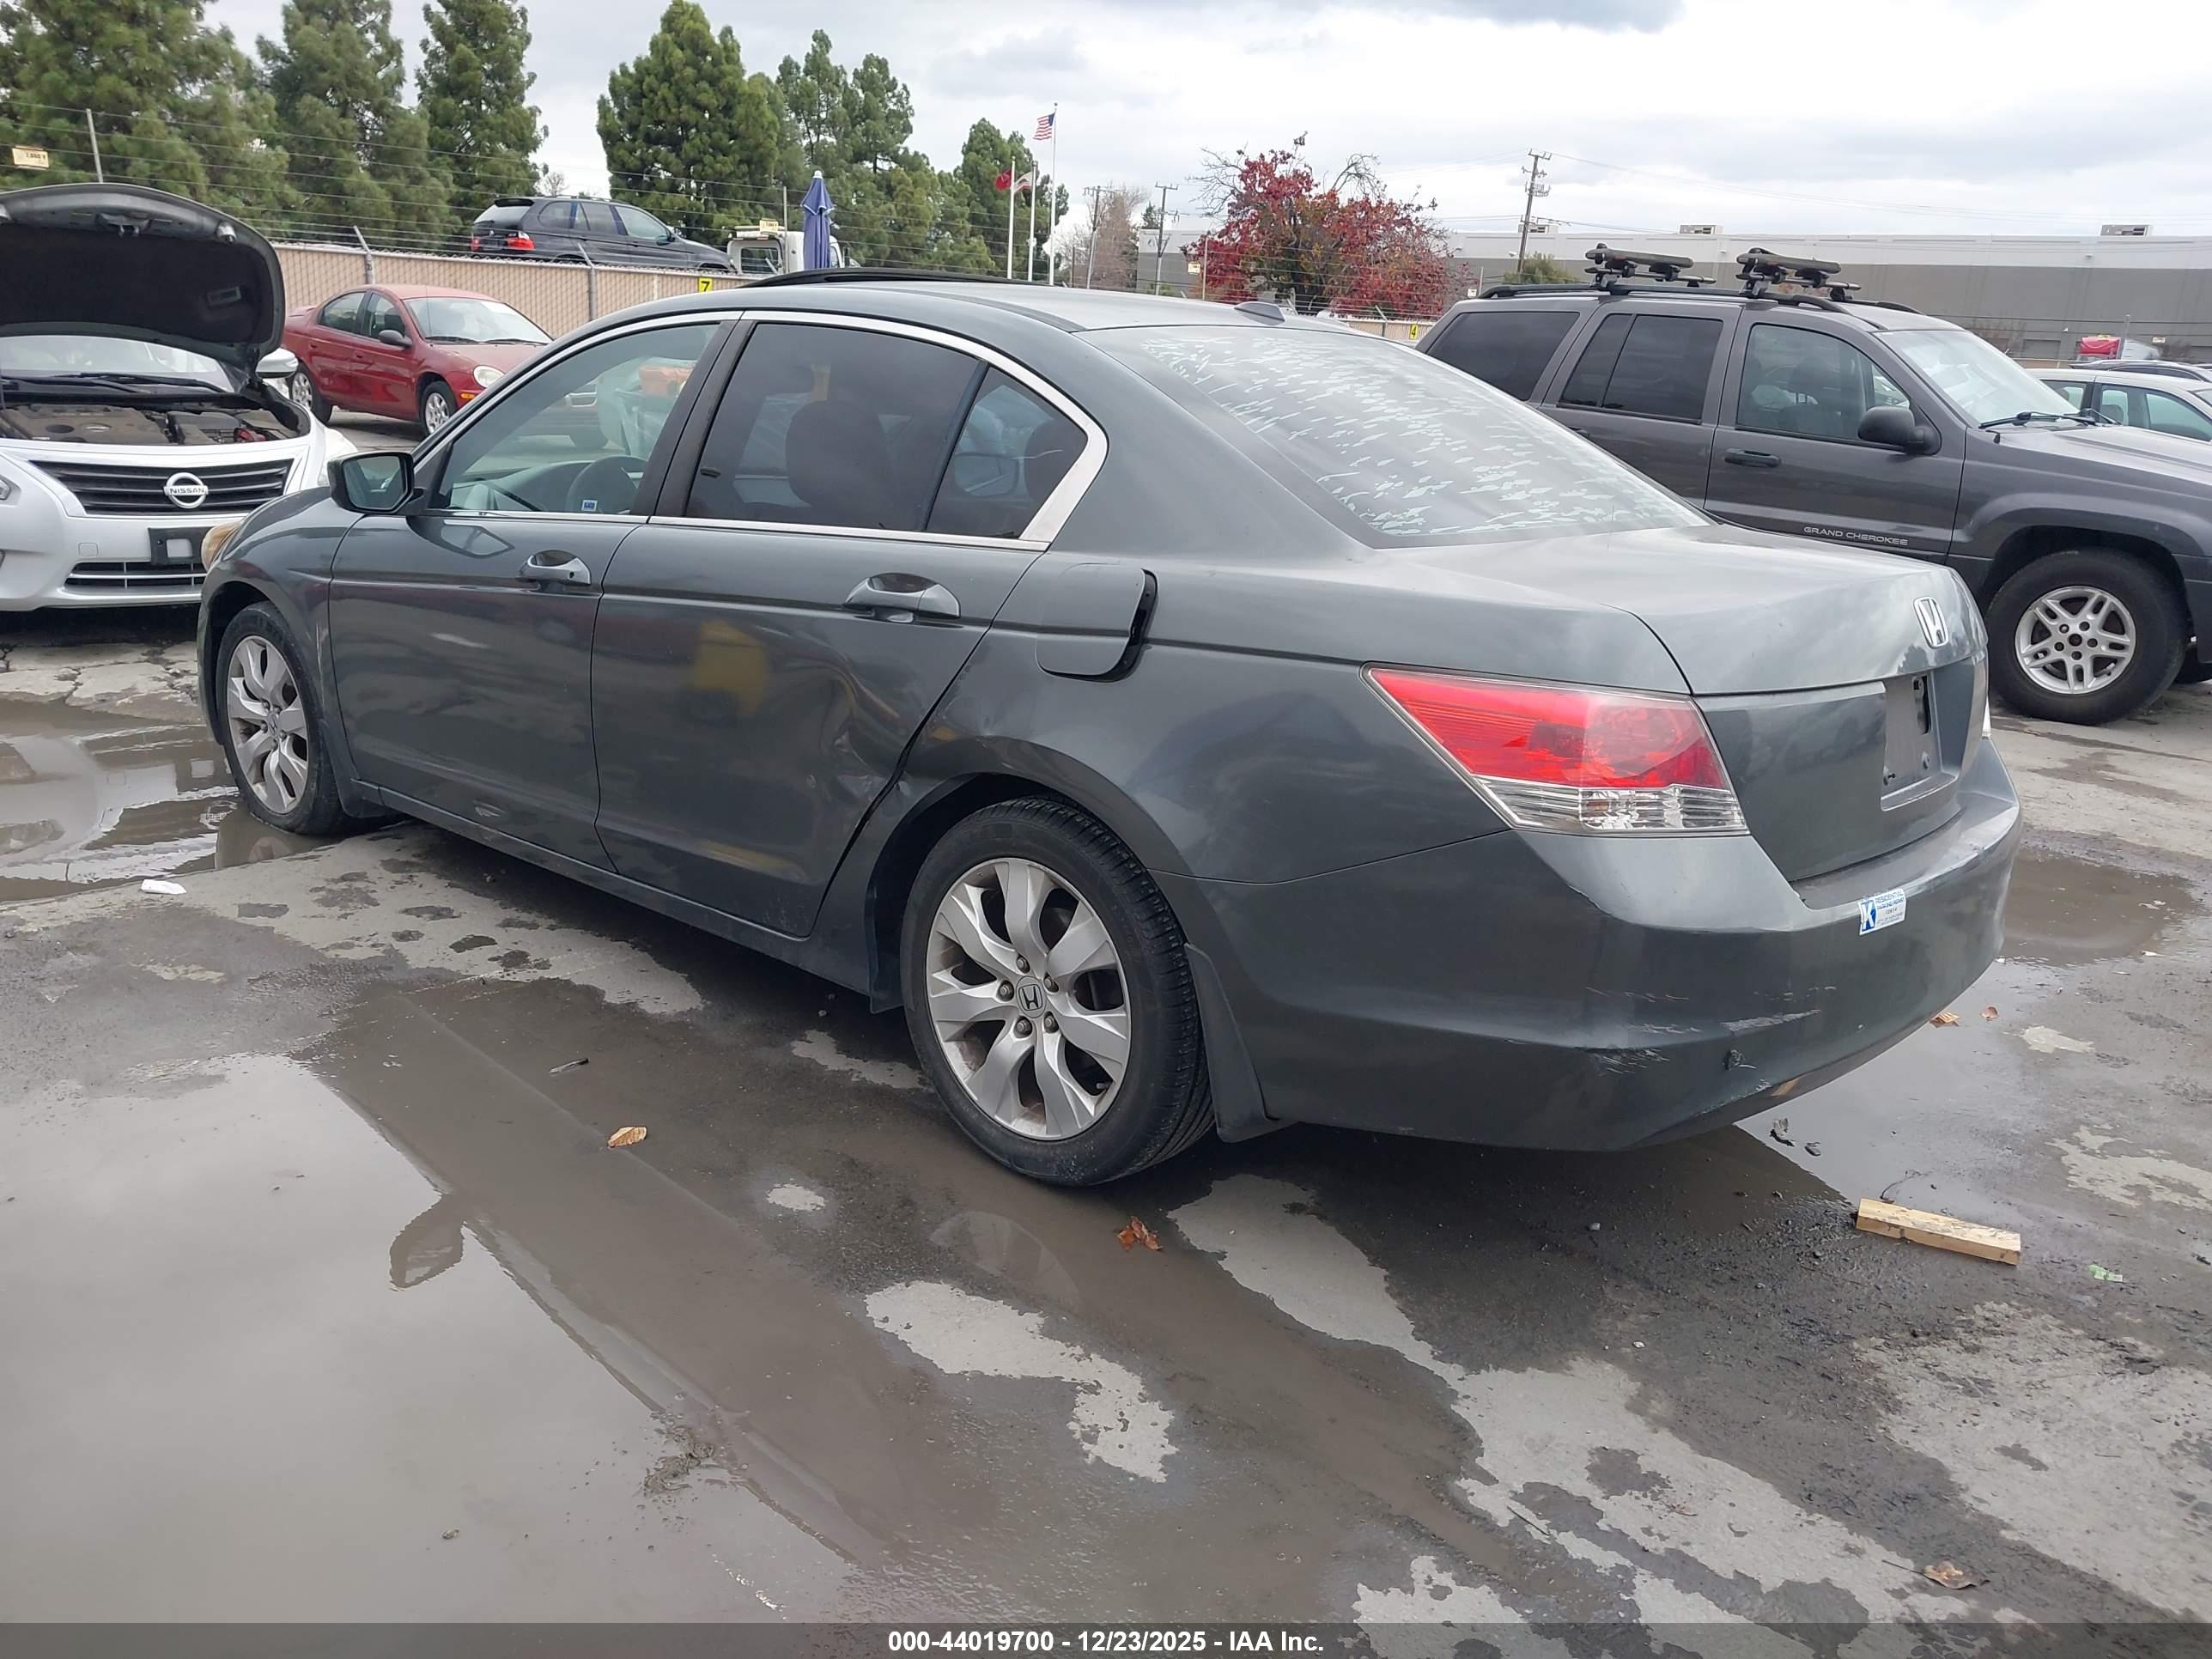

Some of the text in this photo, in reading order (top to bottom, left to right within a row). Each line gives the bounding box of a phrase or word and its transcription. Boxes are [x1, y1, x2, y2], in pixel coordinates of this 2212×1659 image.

[701, 280, 710, 292] 7
[1411, 325, 1417, 337] 4
[1803, 526, 1909, 546] GRAND CHEROKEE
